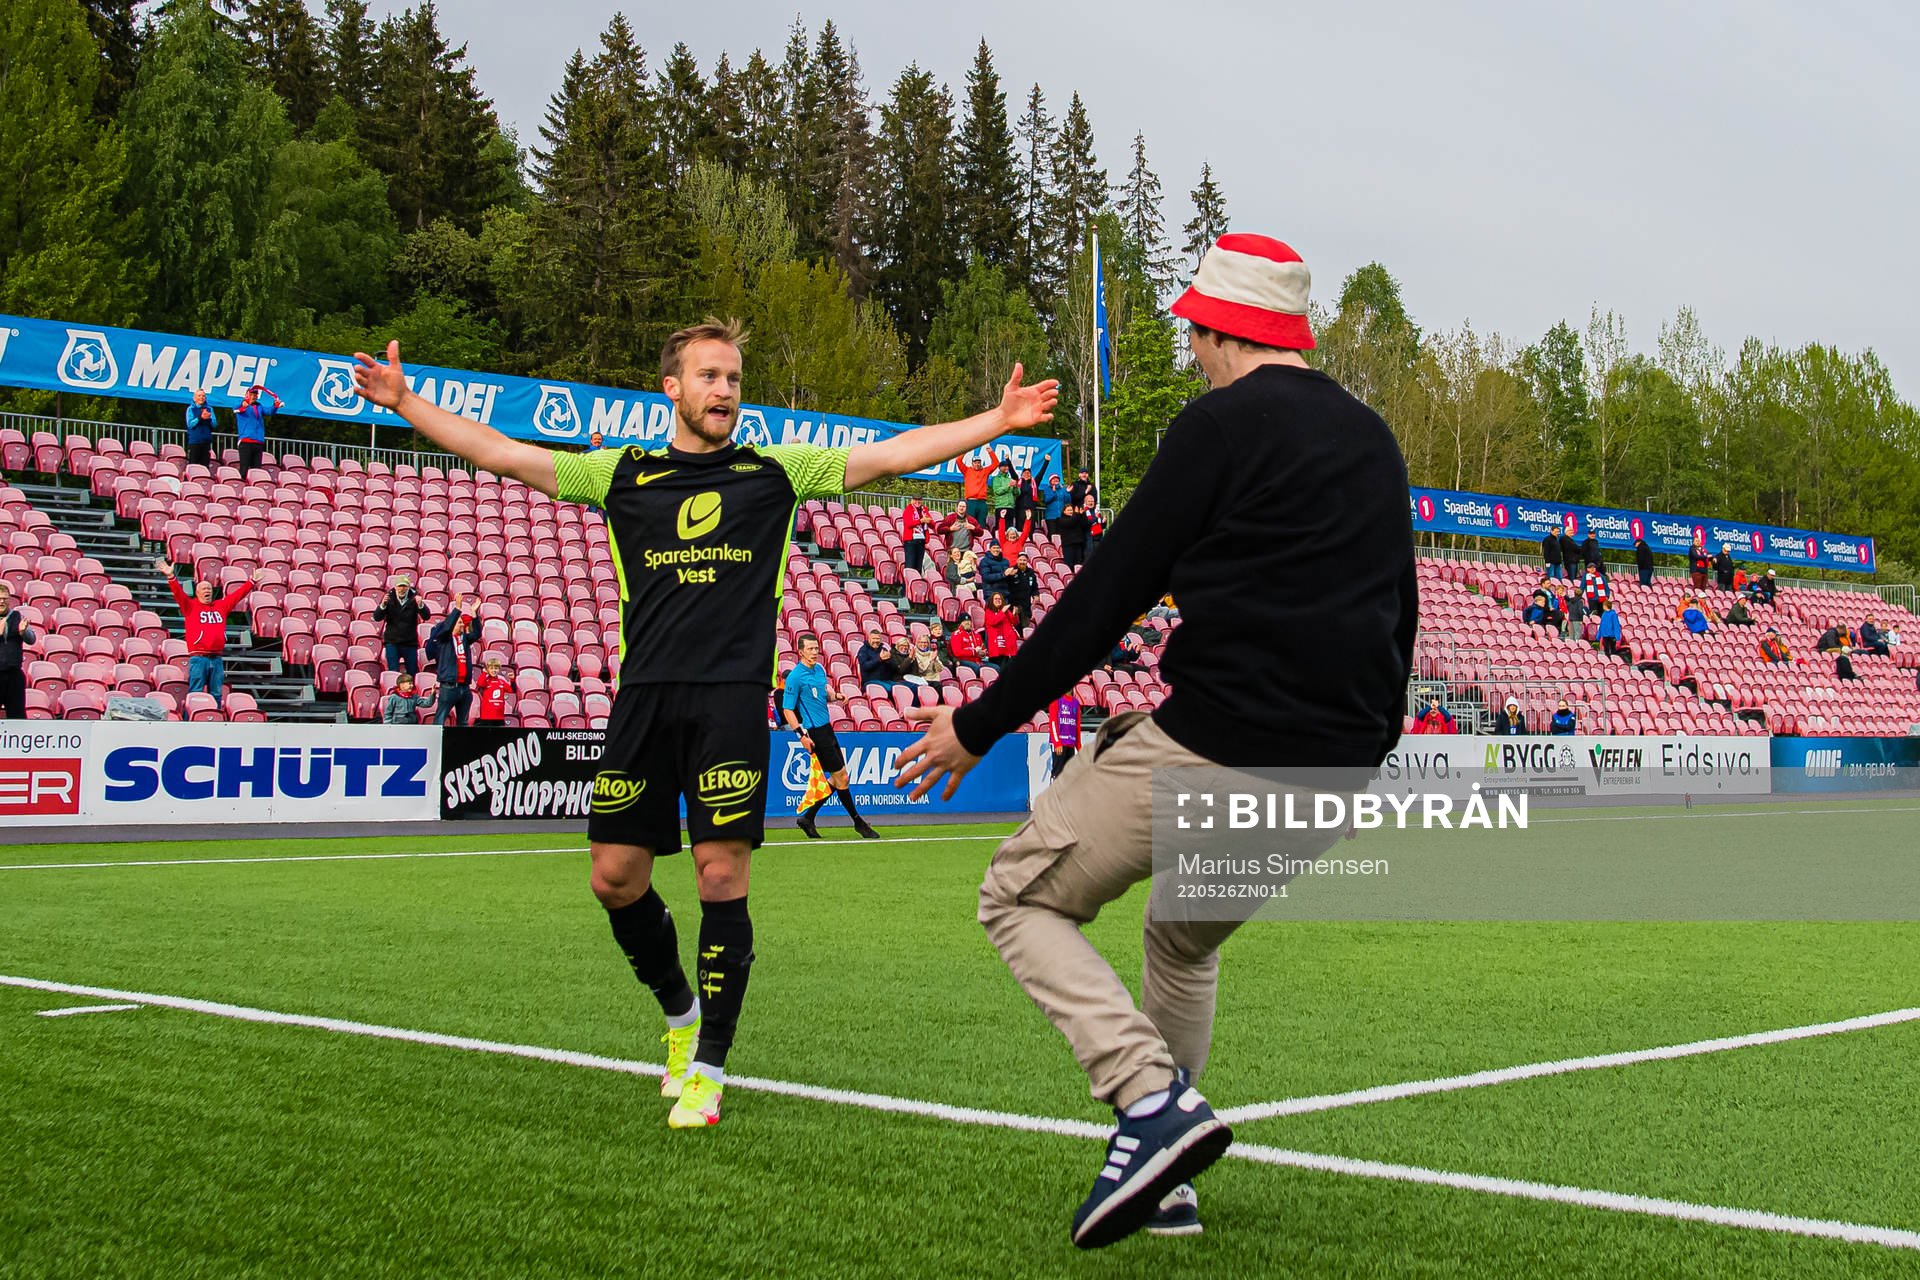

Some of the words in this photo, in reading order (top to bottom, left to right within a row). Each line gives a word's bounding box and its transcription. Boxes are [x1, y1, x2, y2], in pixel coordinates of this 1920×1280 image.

[128, 343, 268, 399] MAPEI
[946, 443, 1034, 477] APEI
[1443, 498, 1492, 517] SpareBank
[1517, 506, 1562, 525] SpareBank
[1457, 516, 1493, 527] ØSTLANDET
[1530, 523, 1564, 534] ØSTLANT
[1586, 514, 1630, 531] SpareBank
[1651, 521, 1692, 537] SpareBank
[1713, 527, 1751, 543] SpareBank
[1770, 534, 1805, 550] SpareBank
[1729, 542, 1752, 552] STLANDET
[1823, 540, 1857, 555] SpareBank
[644, 543, 752, 570] Sparebanken
[676, 566, 717, 584] Vest
[546, 732, 606, 741] AULI-SKEDSMO
[104, 746, 428, 802] SCHÜTZ
[444, 732, 542, 810] SKEDSMO
[1589, 744, 1643, 788] VEFLEN
[1865, 762, 1885, 779] FJELD
[1886, 762, 1896, 777] AS
[594, 776, 640, 799] ERØY
[699, 769, 759, 793] LERØY
[490, 780, 593, 817] BILOPPHO
[855, 795, 872, 806] FOR
[872, 794, 904, 806] NORDISK
